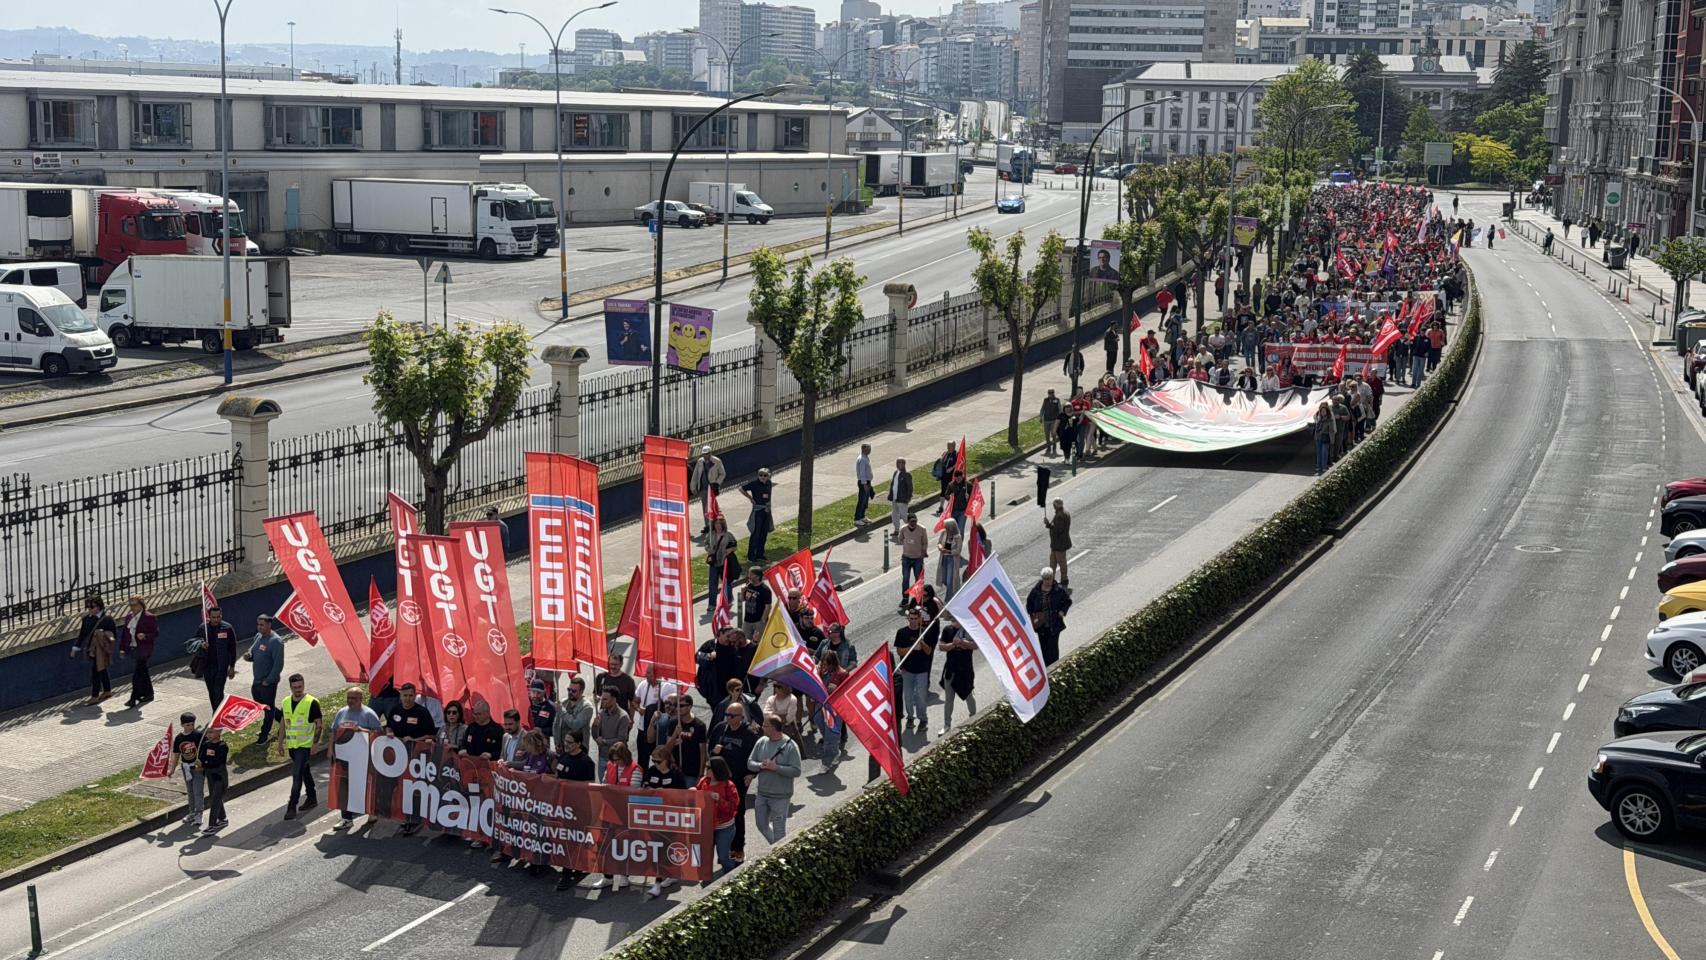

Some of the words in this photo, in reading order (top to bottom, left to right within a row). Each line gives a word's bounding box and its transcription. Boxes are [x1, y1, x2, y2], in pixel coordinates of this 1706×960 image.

[280, 521, 328, 598] UGT
[396, 506, 418, 596] UGT
[422, 544, 457, 629] UGT
[465, 530, 498, 624] UGT
[539, 517, 565, 622] CCOO
[574, 518, 595, 622] CCOO
[656, 521, 683, 631] CCOO
[978, 595, 1042, 690] CCOO
[409, 753, 437, 782] de
[402, 779, 494, 837] maio
[494, 827, 499, 839] E
[500, 830, 565, 857] DEMOCRACIA
[501, 792, 577, 821] TRINCHERAS.
[539, 825, 595, 845] VIVENDA
[633, 808, 695, 828] CCOO
[611, 839, 663, 863] UGT
